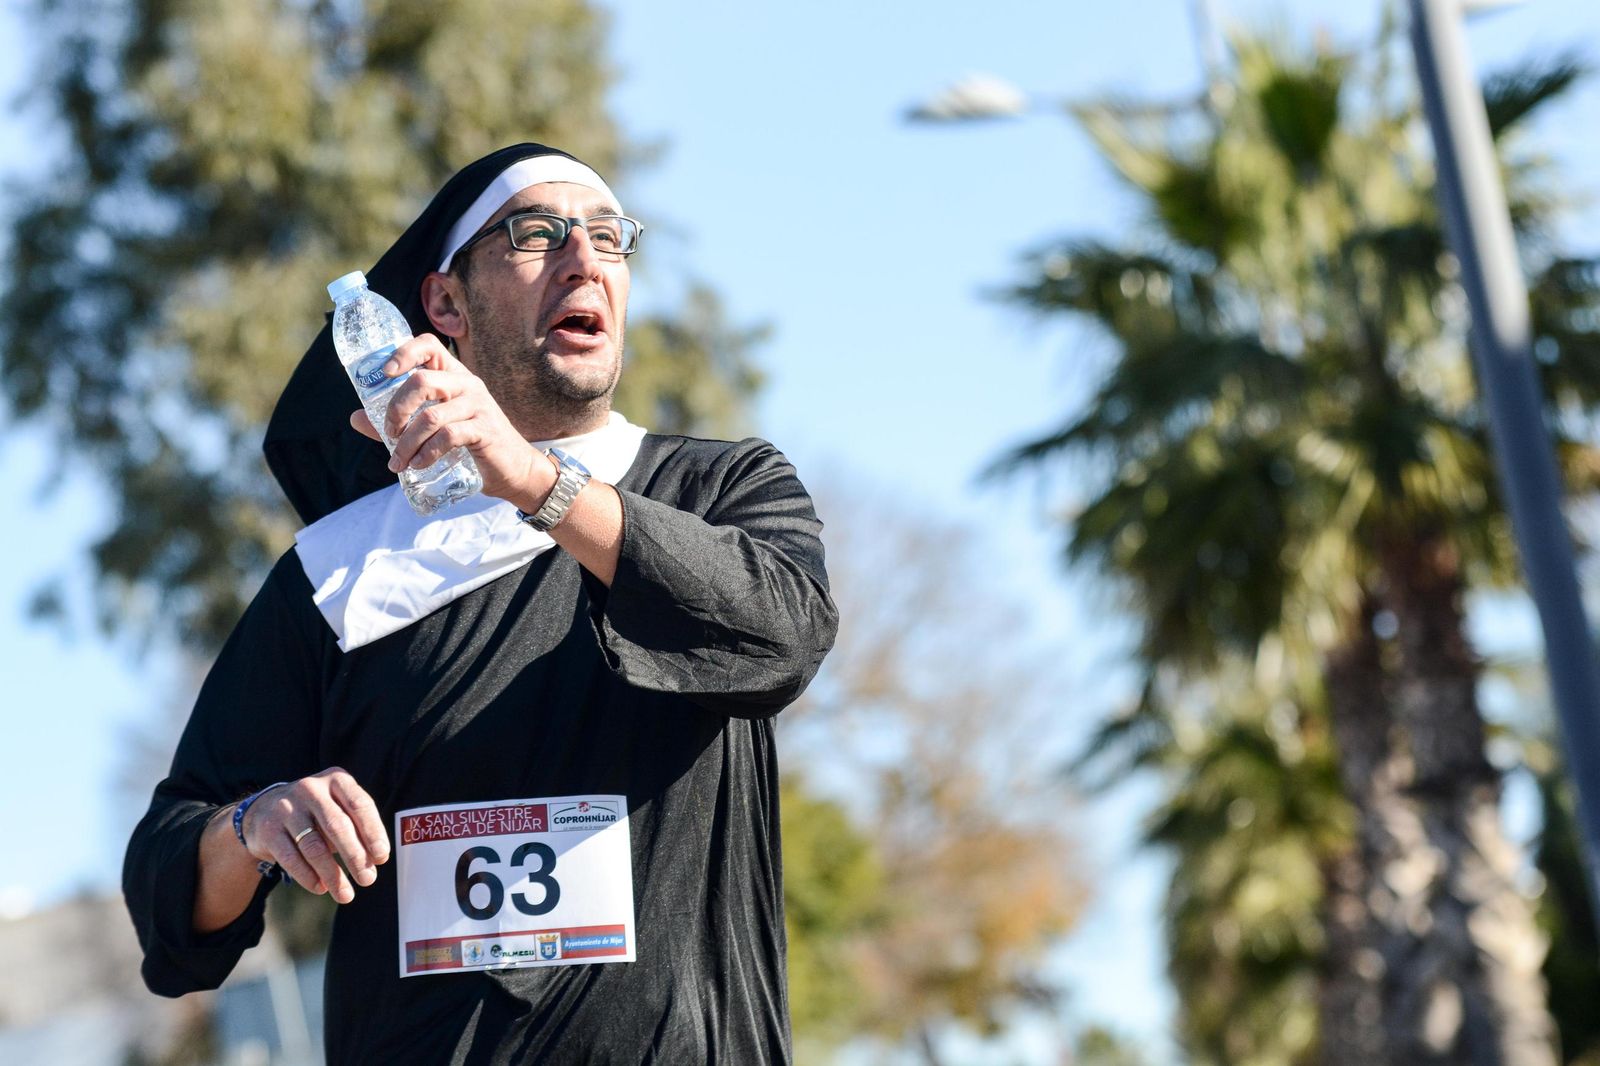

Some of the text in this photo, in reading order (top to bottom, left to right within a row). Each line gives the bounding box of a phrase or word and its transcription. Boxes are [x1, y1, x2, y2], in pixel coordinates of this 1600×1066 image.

[409, 806, 533, 829] IX SAN SILVESTRE
[404, 823, 471, 842] COMARCA
[476, 822, 495, 834] DE
[454, 842, 561, 921] 63
